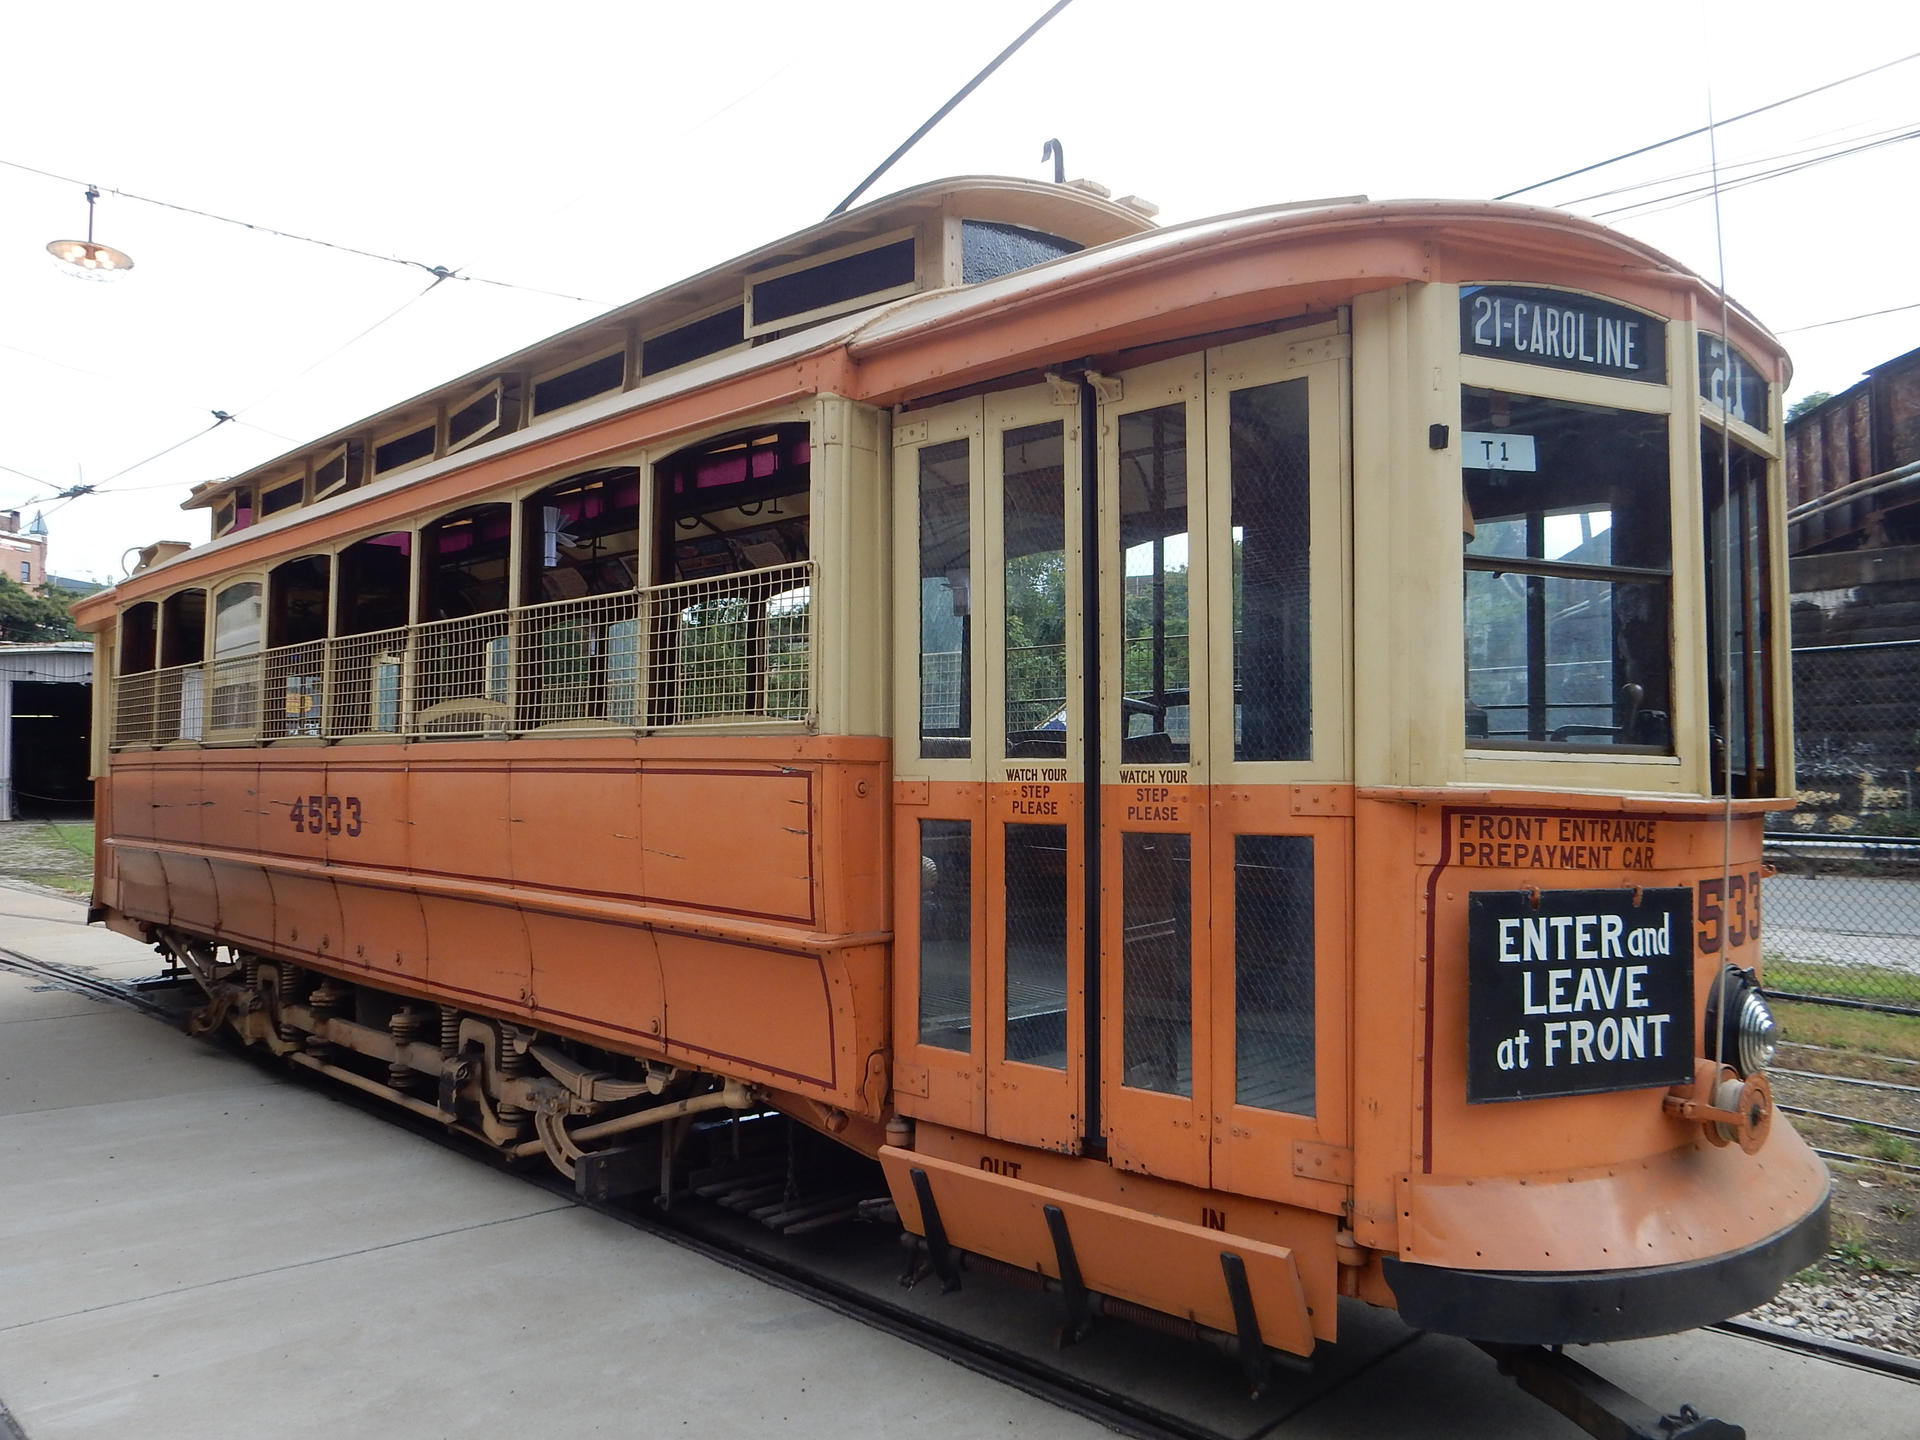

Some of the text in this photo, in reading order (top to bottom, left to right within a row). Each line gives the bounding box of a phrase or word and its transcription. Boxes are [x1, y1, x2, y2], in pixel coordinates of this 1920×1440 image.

[1475, 296, 1639, 370] 21-CAROLINE
[1006, 768, 1067, 782] WATCH YOUR
[1119, 770, 1188, 784] WATCH YOUR
[1021, 785, 1050, 799] STEP
[1136, 788, 1169, 802] STEP
[290, 795, 362, 837] 4533
[1012, 801, 1058, 815] PLEASE
[1127, 806, 1178, 821] PLEASE
[1459, 815, 1657, 844] FRONT ENTRANCE
[1459, 842, 1655, 869] PREPAYMENT CAR
[1698, 872, 1760, 955] 533
[1498, 911, 1670, 963] ENTER and
[1523, 965, 1649, 1016] LEAVE
[1496, 1014, 1671, 1071] at FRONT
[1202, 1208, 1225, 1232] IN
